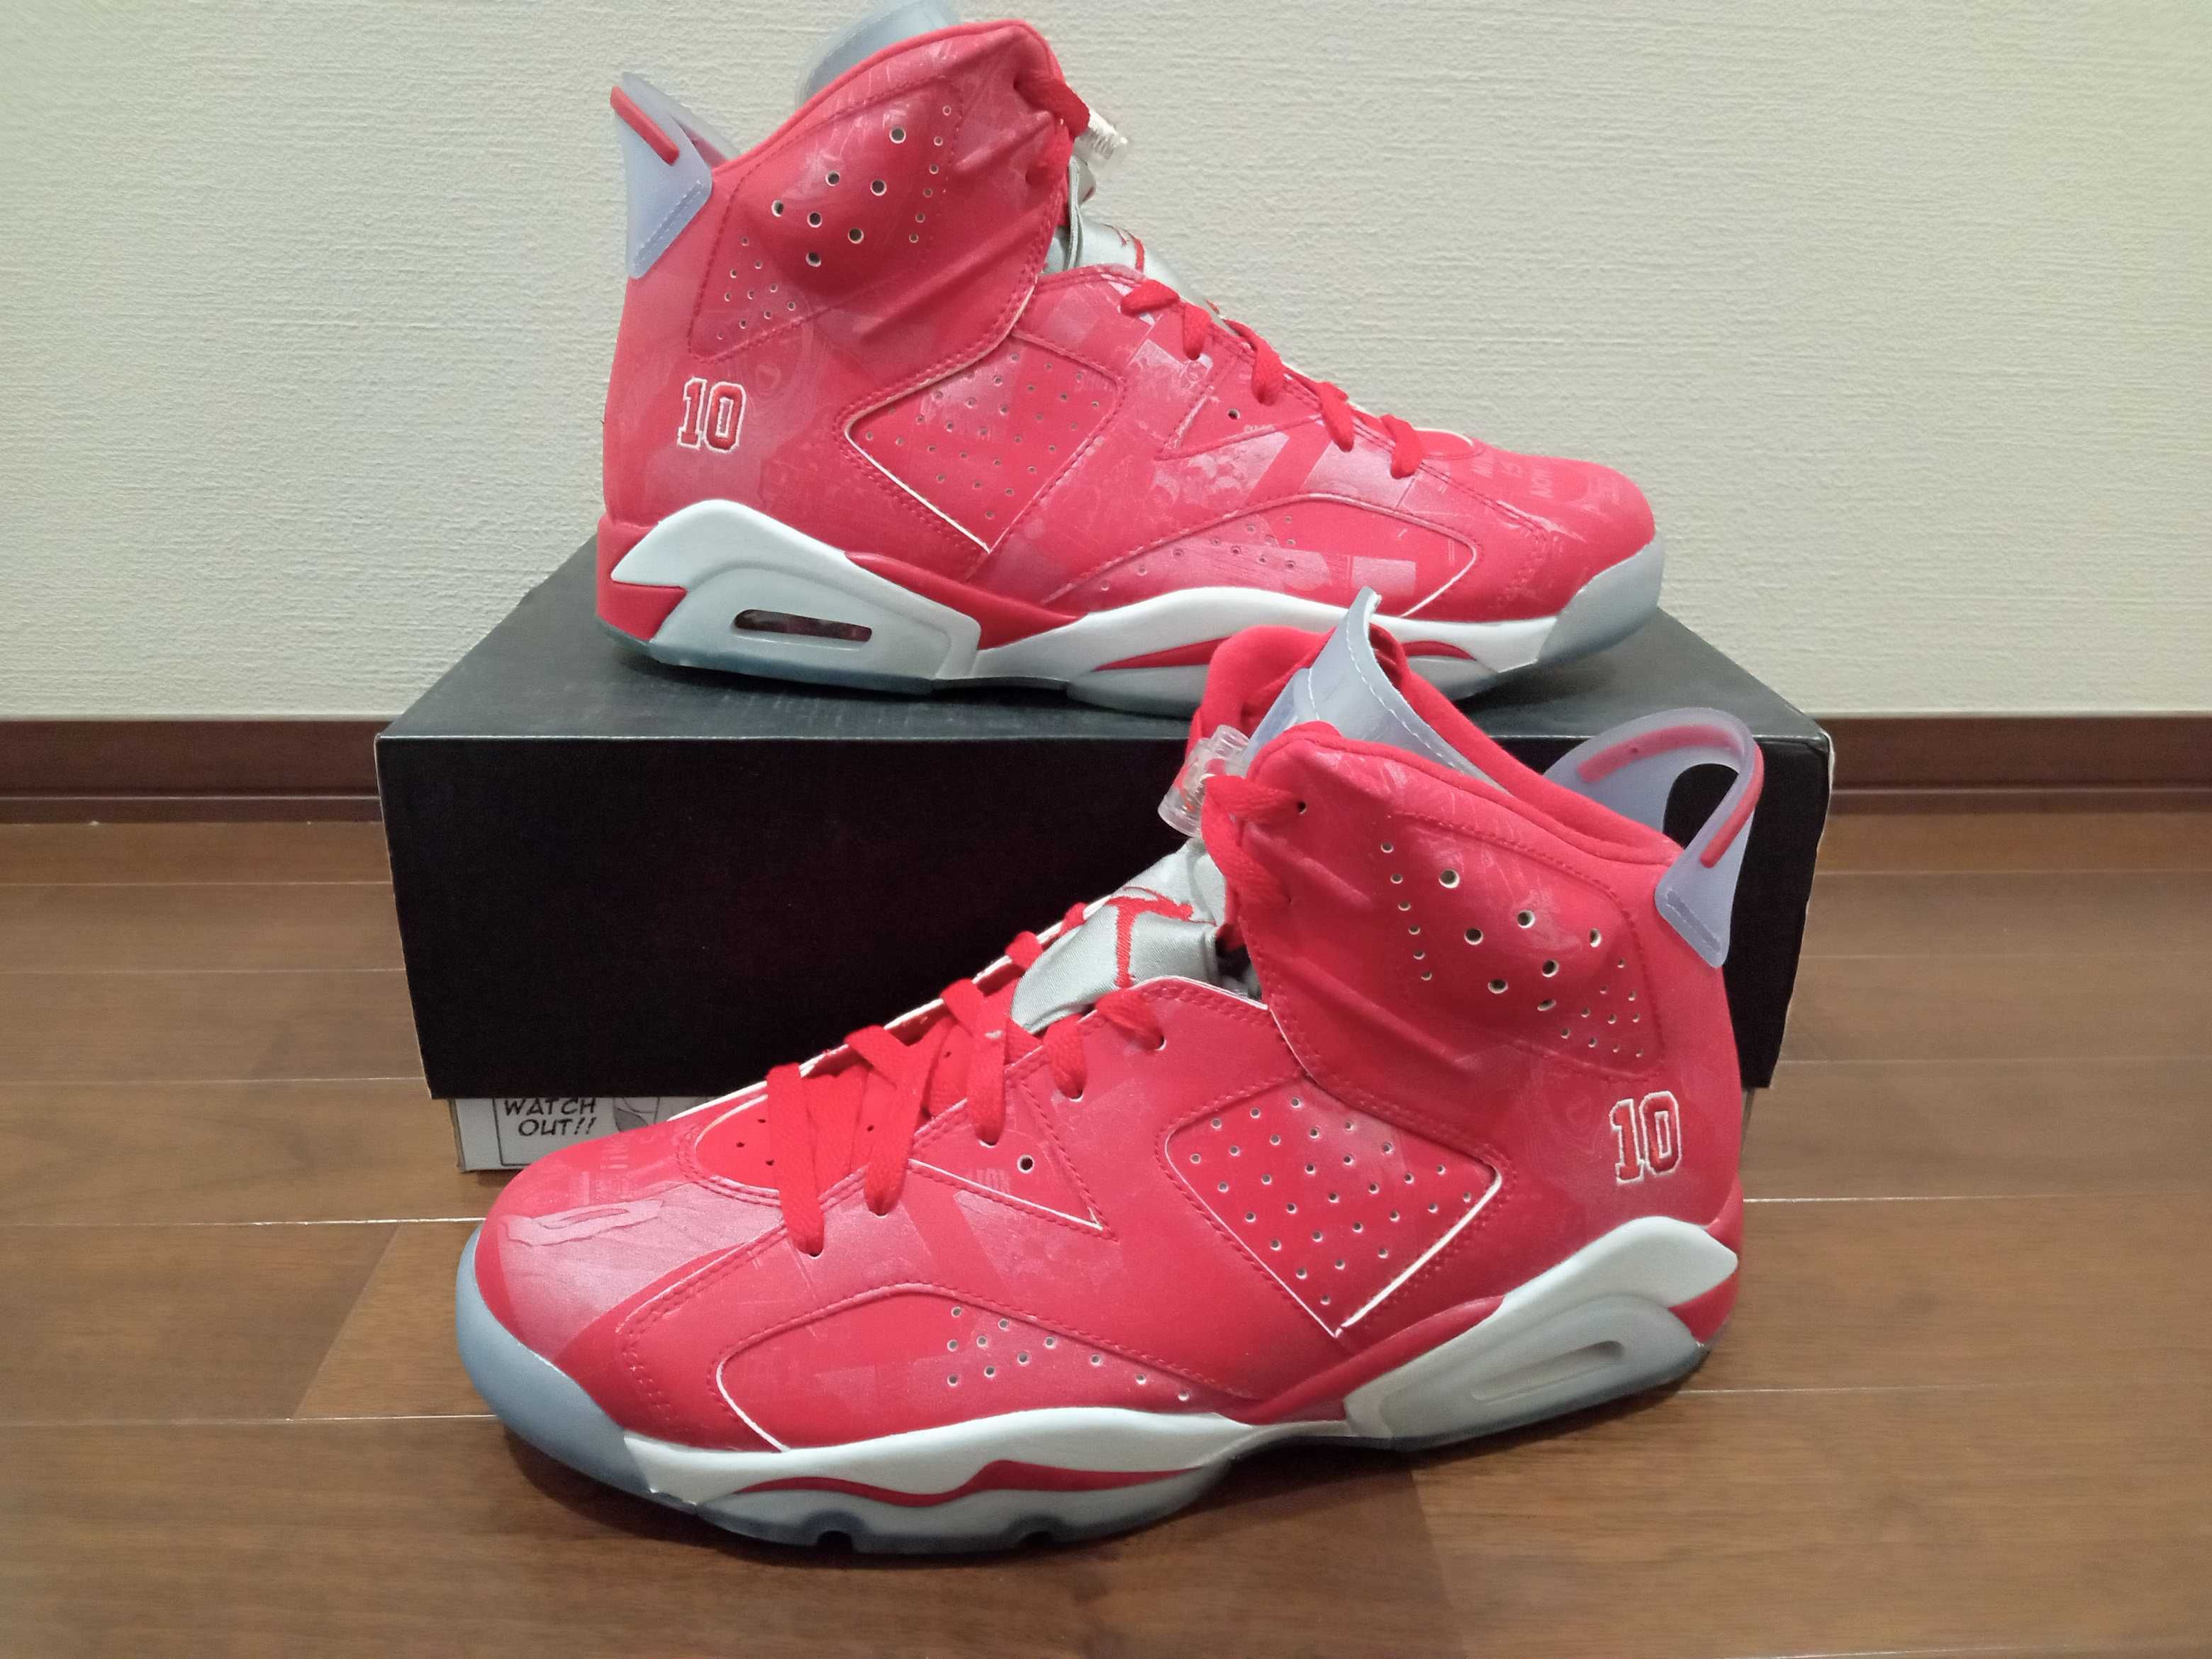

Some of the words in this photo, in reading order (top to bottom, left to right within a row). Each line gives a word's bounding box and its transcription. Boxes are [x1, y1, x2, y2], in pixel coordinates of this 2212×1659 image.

[677, 376, 747, 453] 10
[504, 1097, 596, 1116] WATCH
[518, 1117, 597, 1136] OUT!!
[1609, 1090, 1682, 1185] 10
